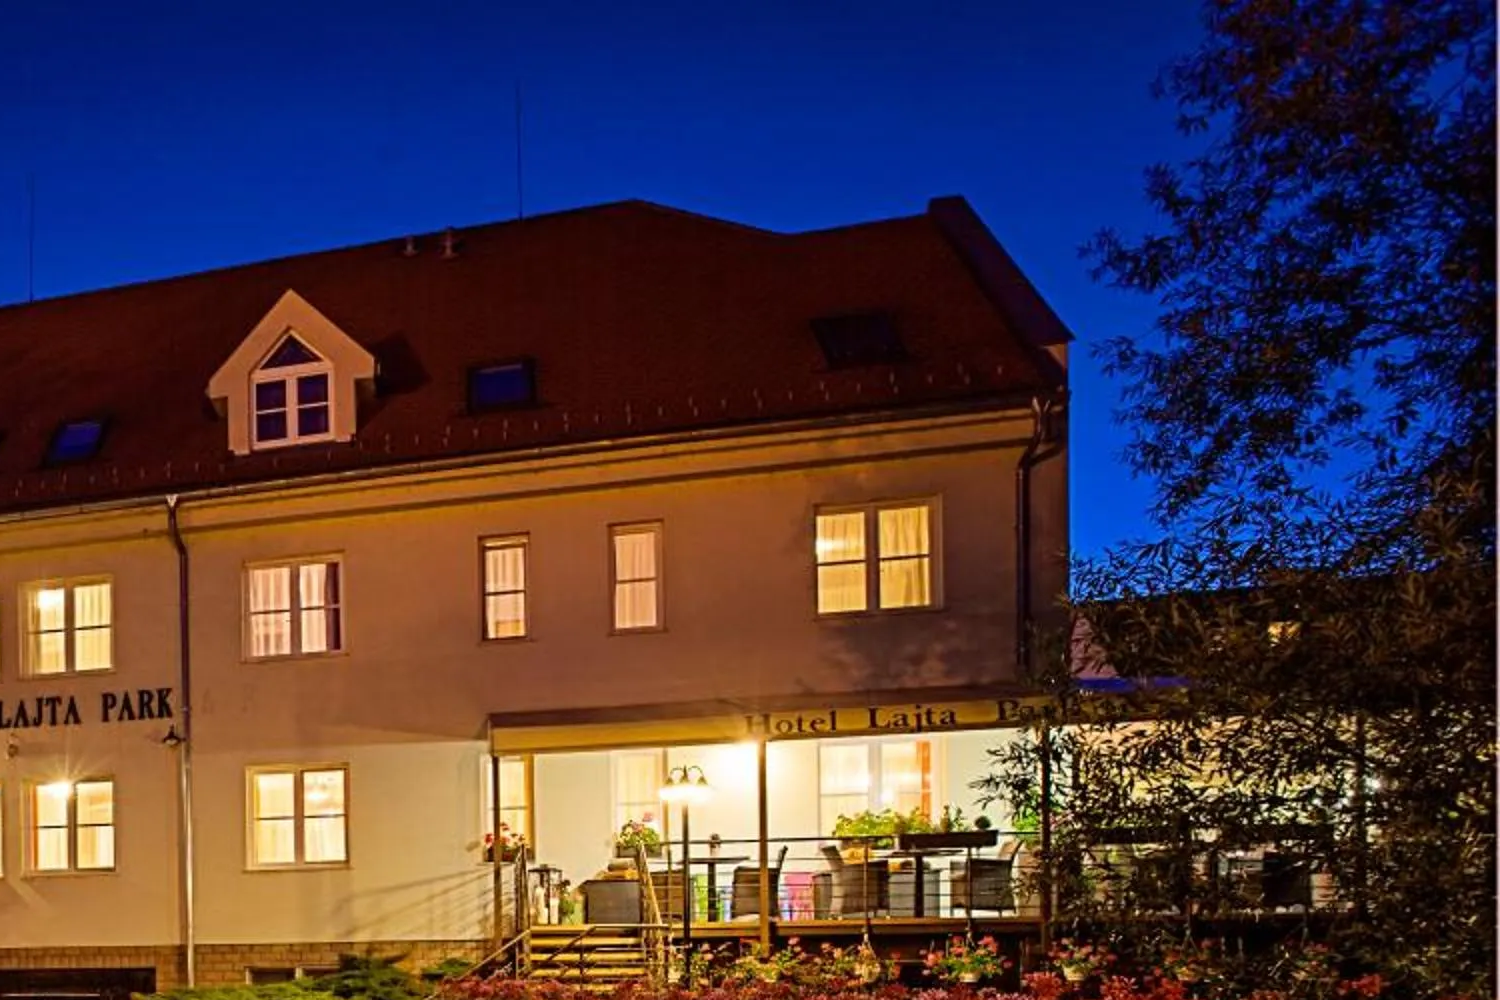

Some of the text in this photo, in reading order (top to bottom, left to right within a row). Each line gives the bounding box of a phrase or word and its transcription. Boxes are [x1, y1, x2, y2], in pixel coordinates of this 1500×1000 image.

[101, 687, 174, 722] PARK
[745, 711, 837, 735] Hotel
[869, 703, 957, 732] Lajta
